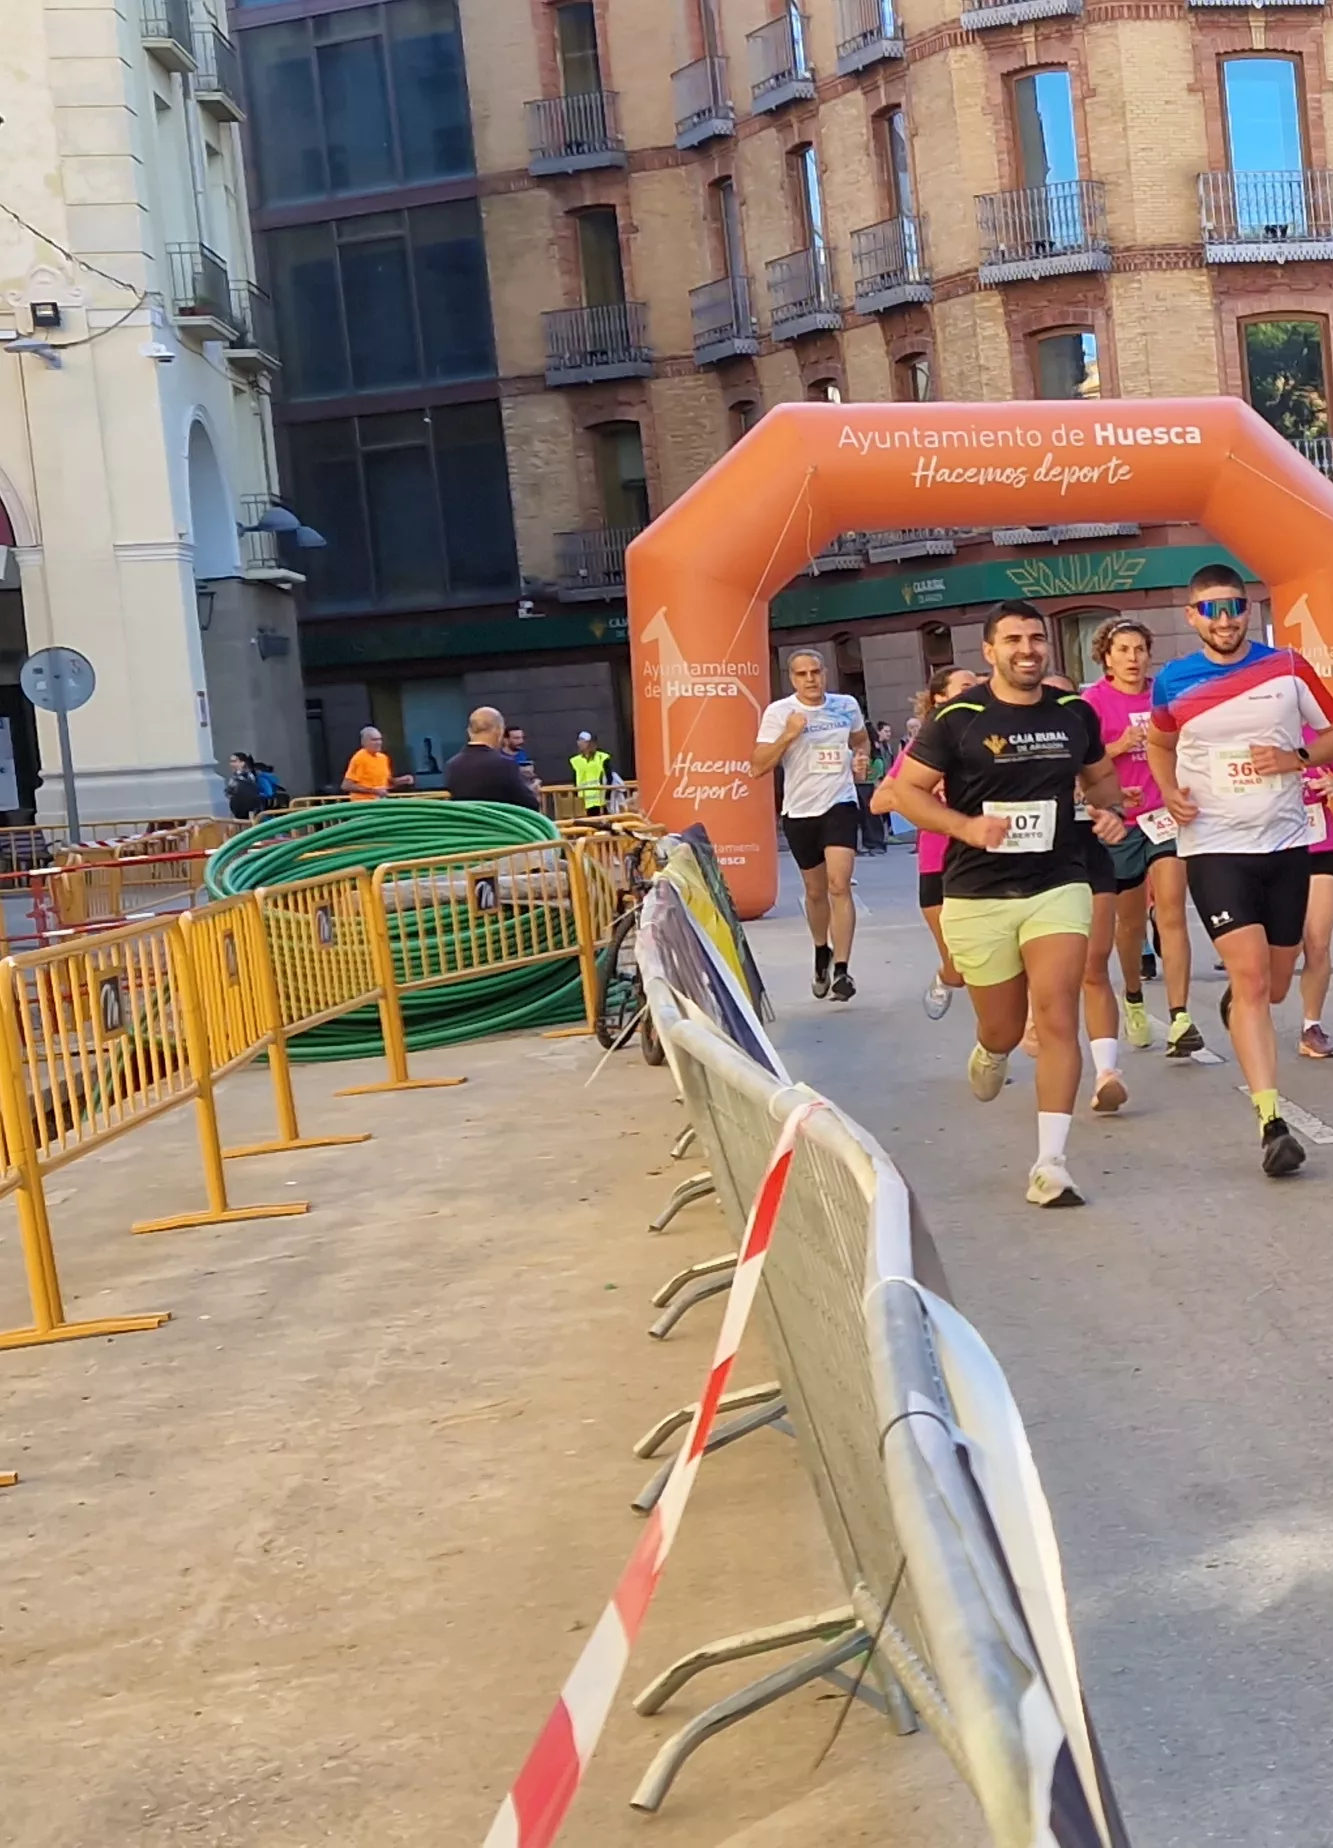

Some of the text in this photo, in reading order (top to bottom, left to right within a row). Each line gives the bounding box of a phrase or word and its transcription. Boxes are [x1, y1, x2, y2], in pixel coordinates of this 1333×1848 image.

[838, 423, 1201, 455] Ayuntamiento de Huesca
[911, 453, 1133, 495] Hacemos deporte
[643, 659, 760, 684] Ayuntamiento
[644, 680, 738, 698] de Huesca
[1008, 731, 1070, 745] CAJA RURAL
[818, 751, 841, 761] 313
[1227, 762, 1260, 777] 36
[673, 775, 749, 811] deporte
[1007, 815, 1041, 831] 07
